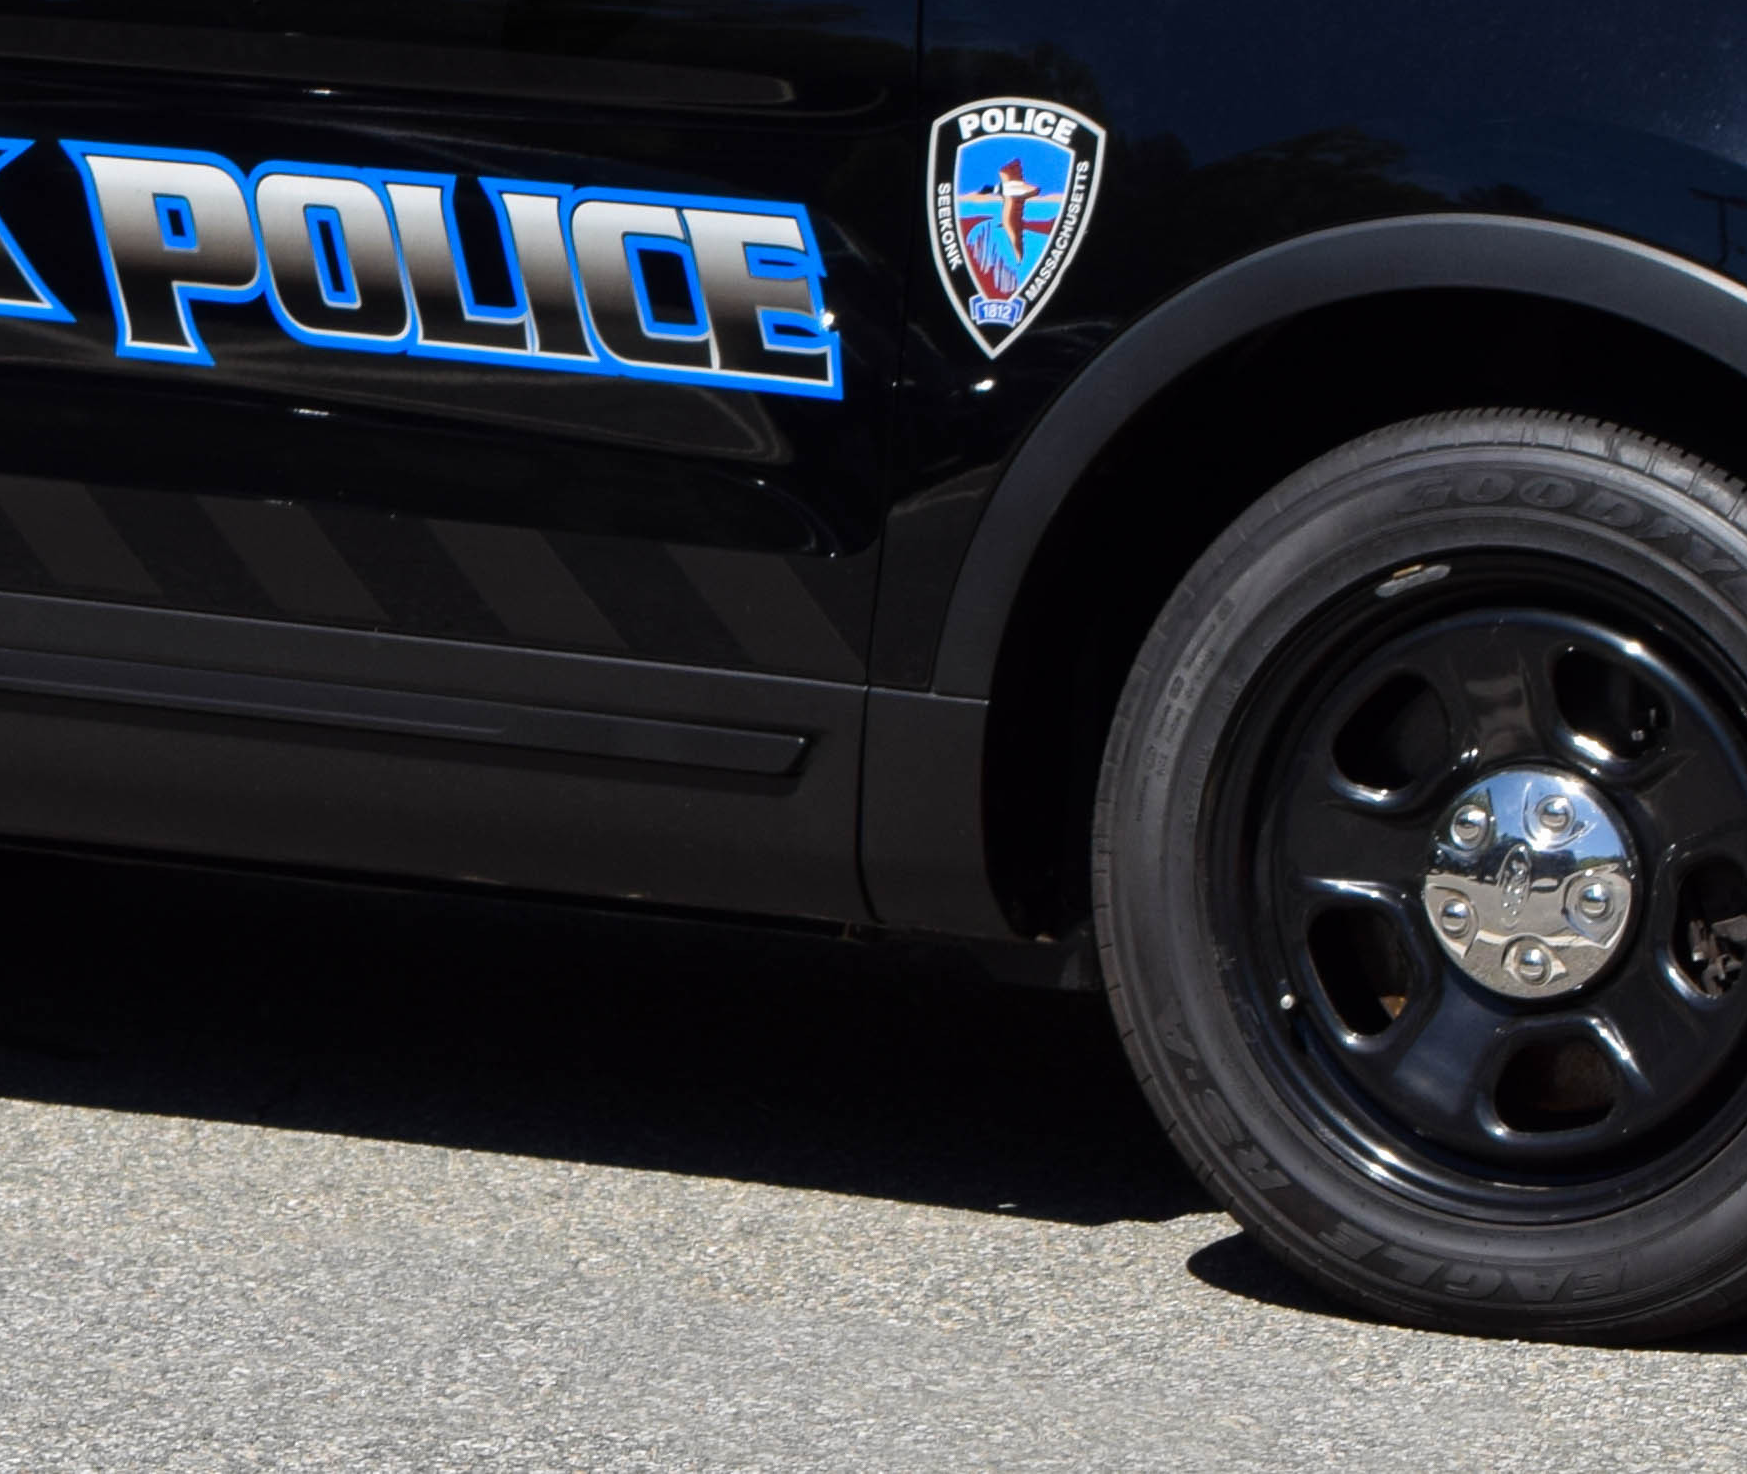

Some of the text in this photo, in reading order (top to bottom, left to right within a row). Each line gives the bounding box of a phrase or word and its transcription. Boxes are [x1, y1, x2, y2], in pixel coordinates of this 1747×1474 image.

[958, 106, 1078, 145] POLICE
[59, 140, 843, 399] POLICE
[938, 182, 963, 271] SEEKONK
[1025, 160, 1090, 301] MASSACHUSETTS
[982, 304, 1013, 319] 1812
[1316, 1220, 1627, 1306] EAGLE
